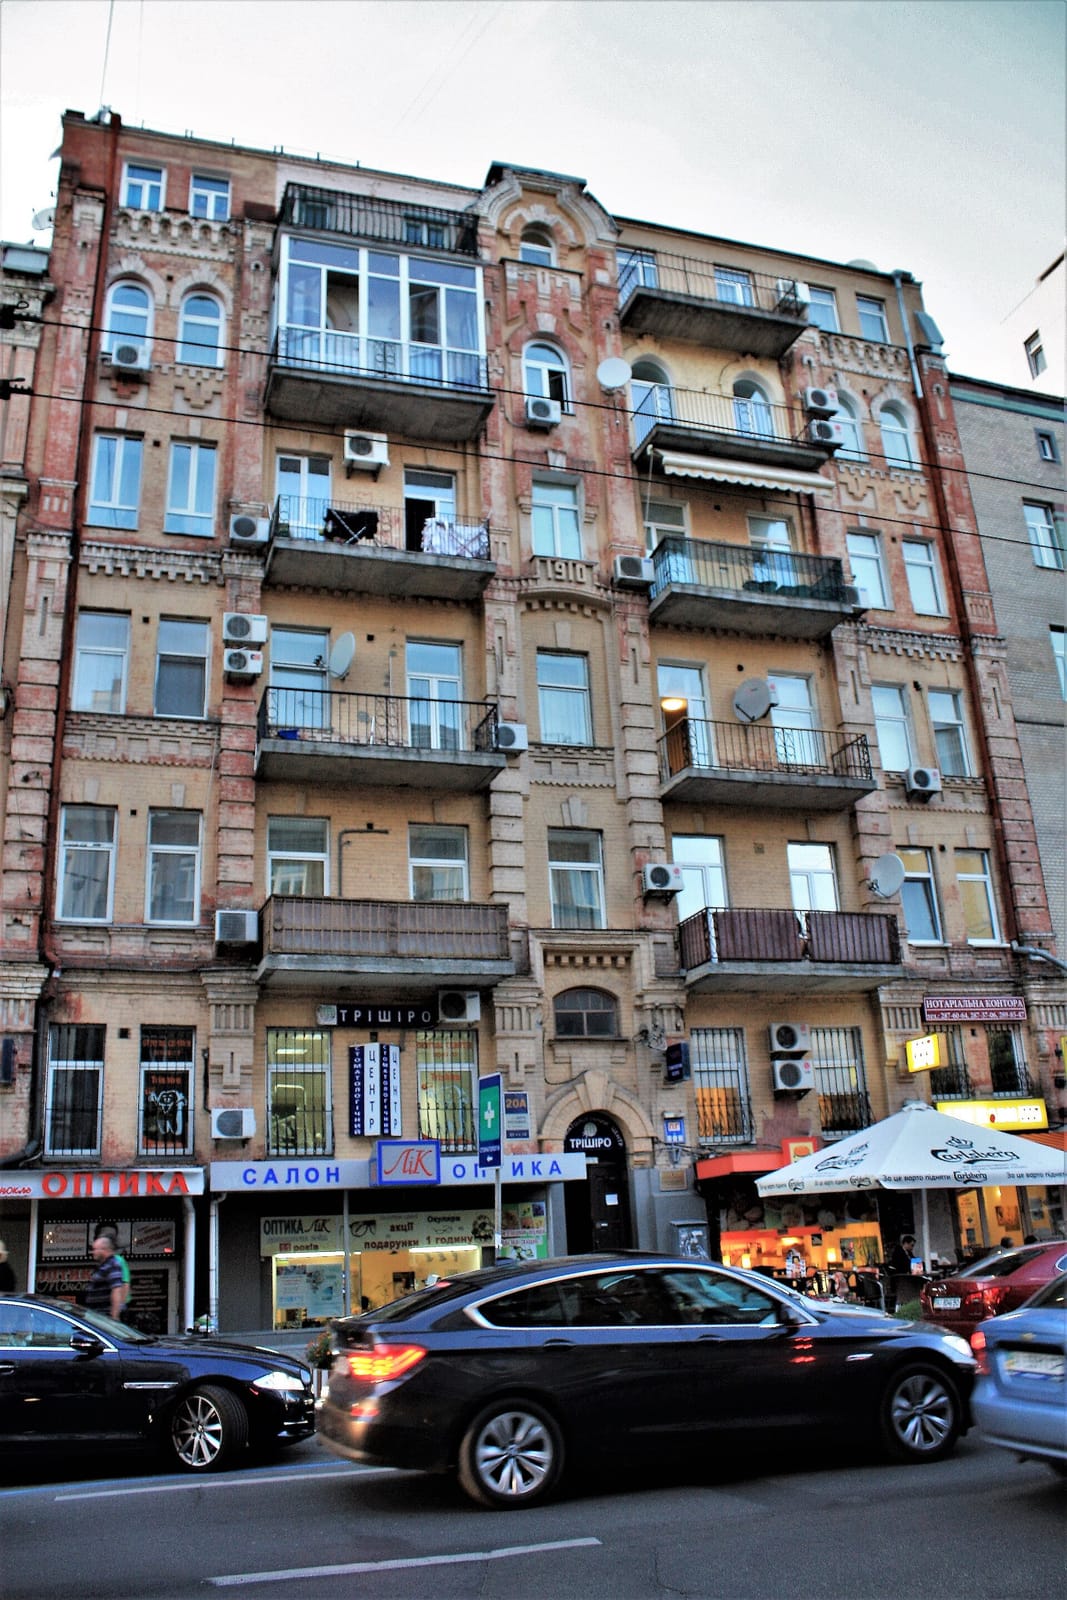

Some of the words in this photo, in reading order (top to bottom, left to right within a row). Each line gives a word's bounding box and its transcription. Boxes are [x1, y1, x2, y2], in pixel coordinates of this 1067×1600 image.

[547, 560, 587, 582] 1910
[926, 999, 985, 1009] НОТАРІАЛЬНА
[986, 999, 1025, 1009] КОНТОРА
[340, 1009, 431, 1023] ТРІШІРО
[368, 1050, 376, 1129] ЦЕНТР
[569, 1137, 612, 1149] ТРІШІРО
[930, 1147, 1020, 1164] Carlsberg
[242, 1167, 340, 1185] САЛОН
[452, 1160, 562, 1179] ОПИКА
[953, 1170, 988, 1184] Carlsberg
[41, 1171, 190, 1197] ОПТИКА
[263, 1218, 304, 1236] ОПТИКА
[364, 1239, 419, 1250] подарунки
[435, 1235, 473, 1244] годину
